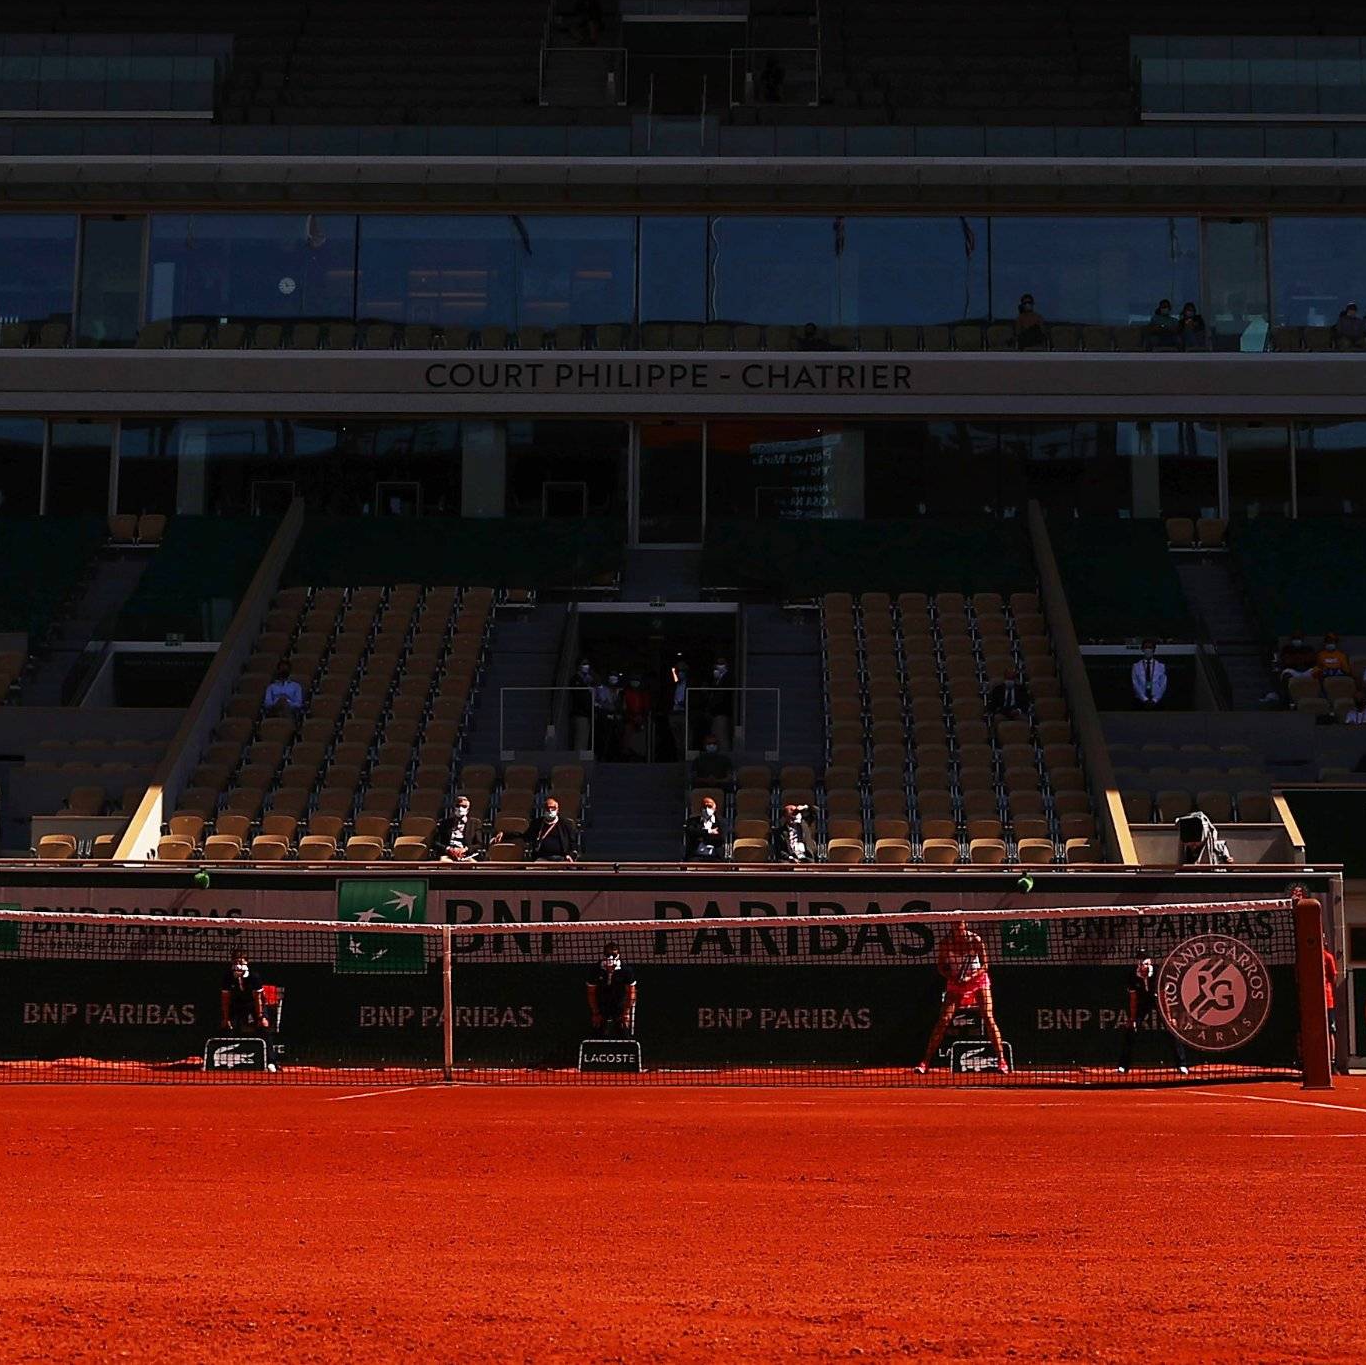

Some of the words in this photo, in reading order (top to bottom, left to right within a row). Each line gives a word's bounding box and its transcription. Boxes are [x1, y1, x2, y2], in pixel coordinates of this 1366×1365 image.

[425, 364, 544, 388] COURT
[555, 364, 709, 389] PHILIPPE
[741, 364, 913, 389] CHATRIER
[445, 899, 581, 954] BNP
[654, 900, 935, 956] PARIBAS
[1165, 941, 1207, 1007] ROLAND
[1213, 941, 1265, 1001] GARROS
[23, 1002, 78, 1025] BNP
[84, 1002, 196, 1025] PARIBAS
[359, 1005, 415, 1027] BNP
[698, 1007, 753, 1029] BNP
[759, 1007, 873, 1029] PARIBAS
[1037, 1008, 1092, 1030] BNP
[1184, 1017, 1253, 1042] PARIS
[583, 1053, 636, 1063] LACOSTE
